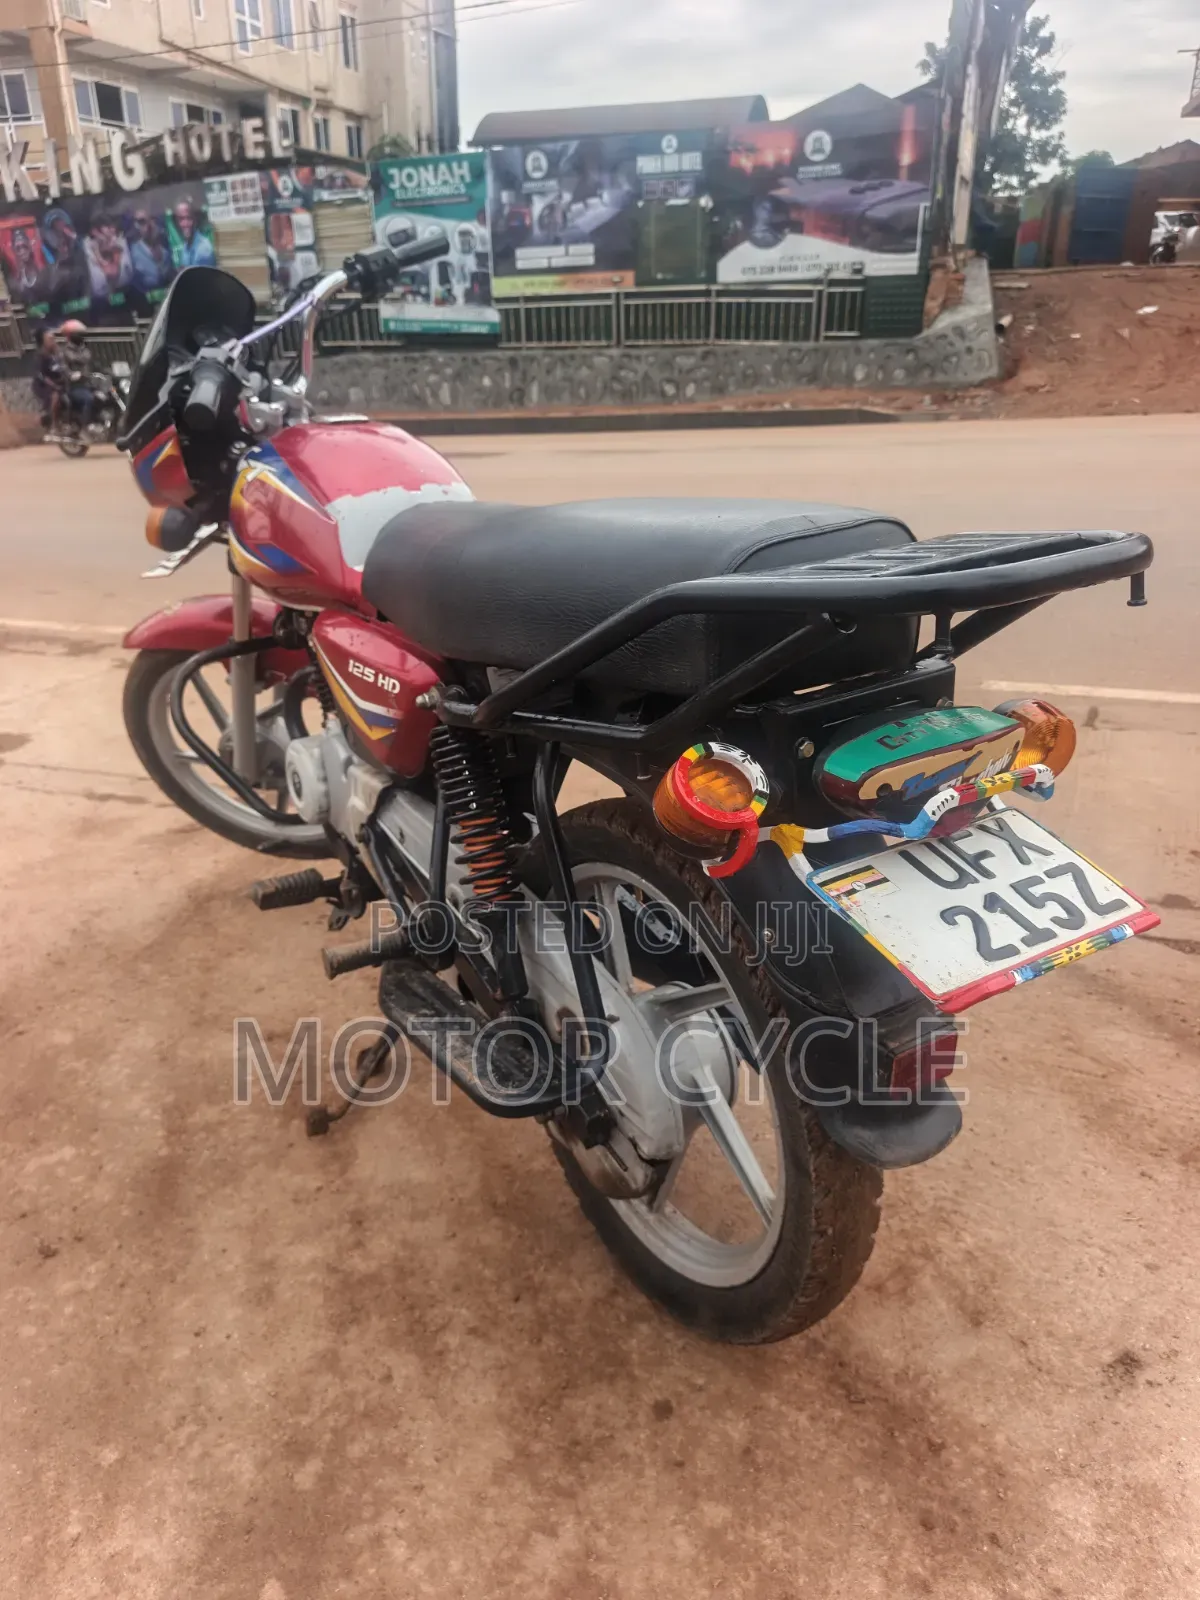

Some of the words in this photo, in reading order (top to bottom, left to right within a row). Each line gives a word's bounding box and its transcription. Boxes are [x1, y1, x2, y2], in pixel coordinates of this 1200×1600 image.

[0, 127, 148, 201] KING
[162, 115, 296, 167] HOTEL
[387, 161, 472, 190] JONAH
[347, 659, 376, 683] 125
[377, 673, 401, 694] HD
[898, 817, 1054, 890] UFX
[939, 862, 1129, 963] 215Z
